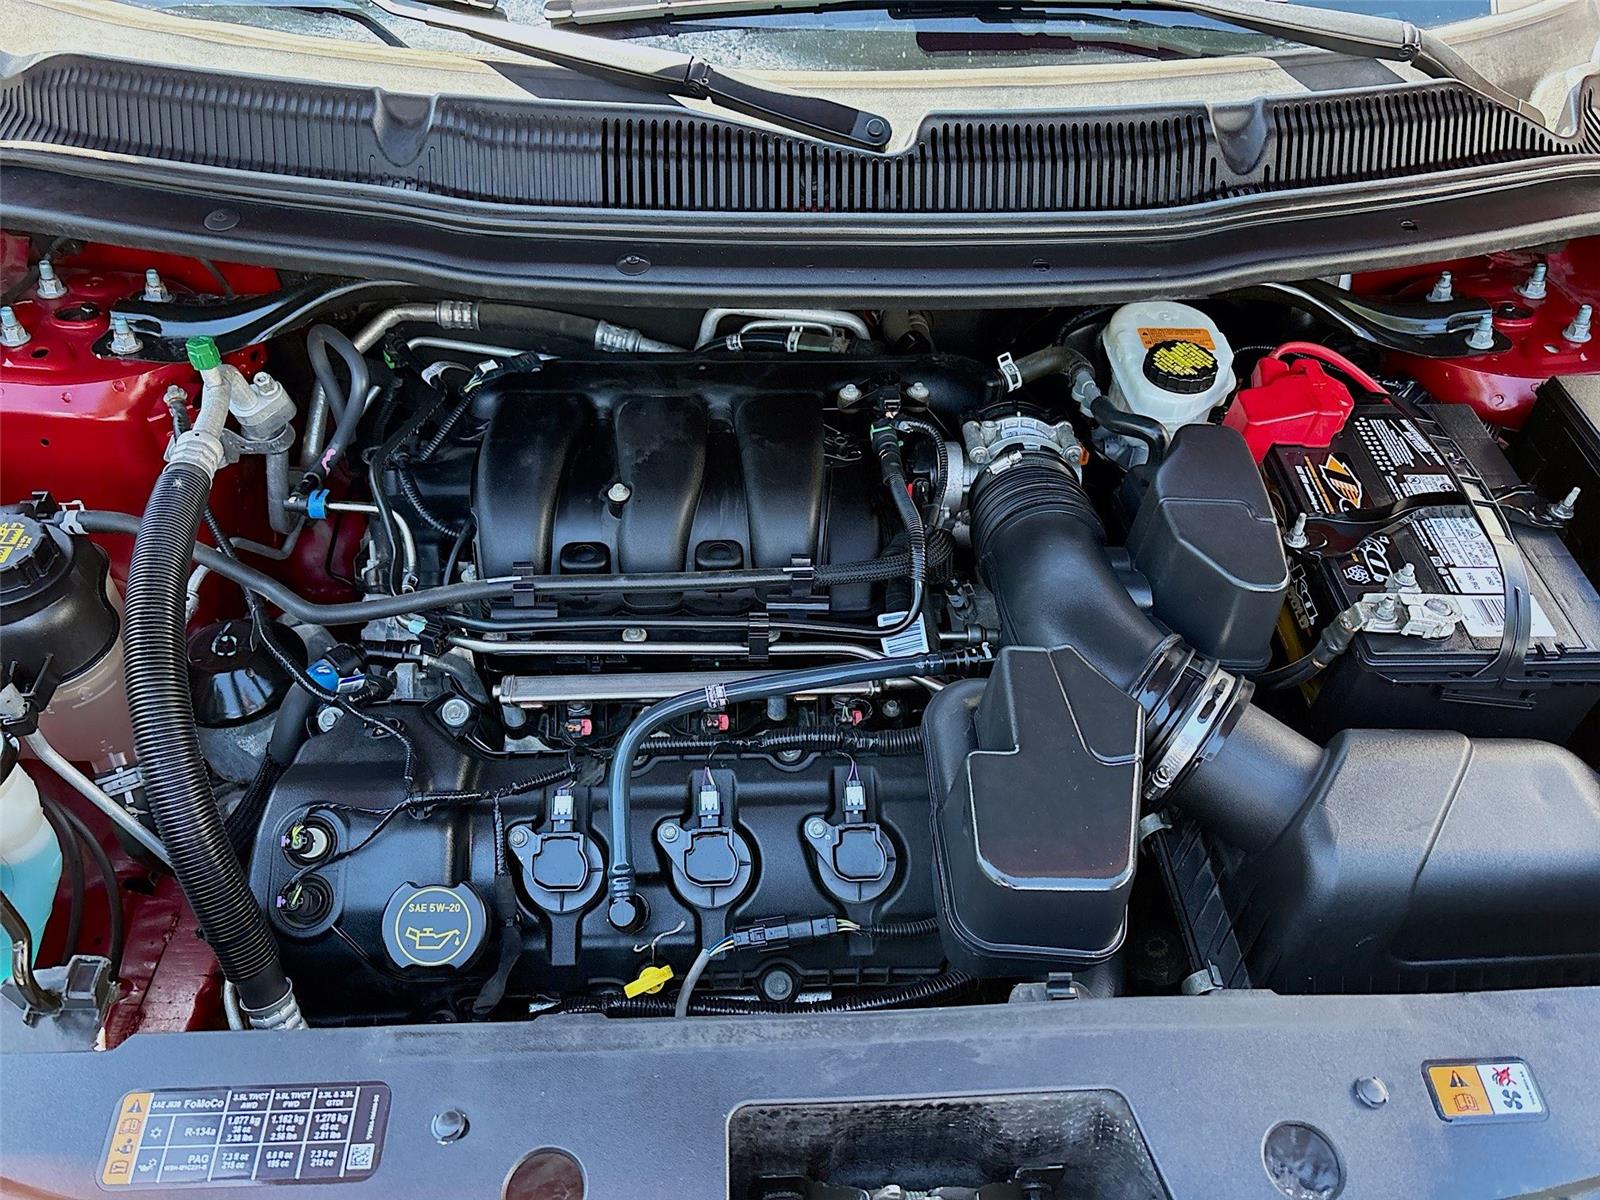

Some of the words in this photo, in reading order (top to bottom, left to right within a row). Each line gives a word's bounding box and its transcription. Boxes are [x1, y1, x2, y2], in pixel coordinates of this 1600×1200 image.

[408, 903, 428, 913] SAE
[429, 903, 461, 913] 5W-20
[184, 1098, 225, 1109] FoMoCo
[227, 1116, 250, 1125] 1.077
[249, 1116, 261, 1127] kg
[271, 1114, 294, 1124] 1.162
[294, 1114, 305, 1125] kg
[314, 1113, 337, 1123] 1.276
[337, 1113, 348, 1124] kg
[184, 1126, 216, 1137] R-134a
[319, 1123, 329, 1131] 45
[188, 1154, 209, 1164] PAG
[222, 1152, 233, 1161] 7.3
[310, 1150, 321, 1158] 7.3
[221, 1161, 235, 1169] 215
[310, 1158, 324, 1167] 215
